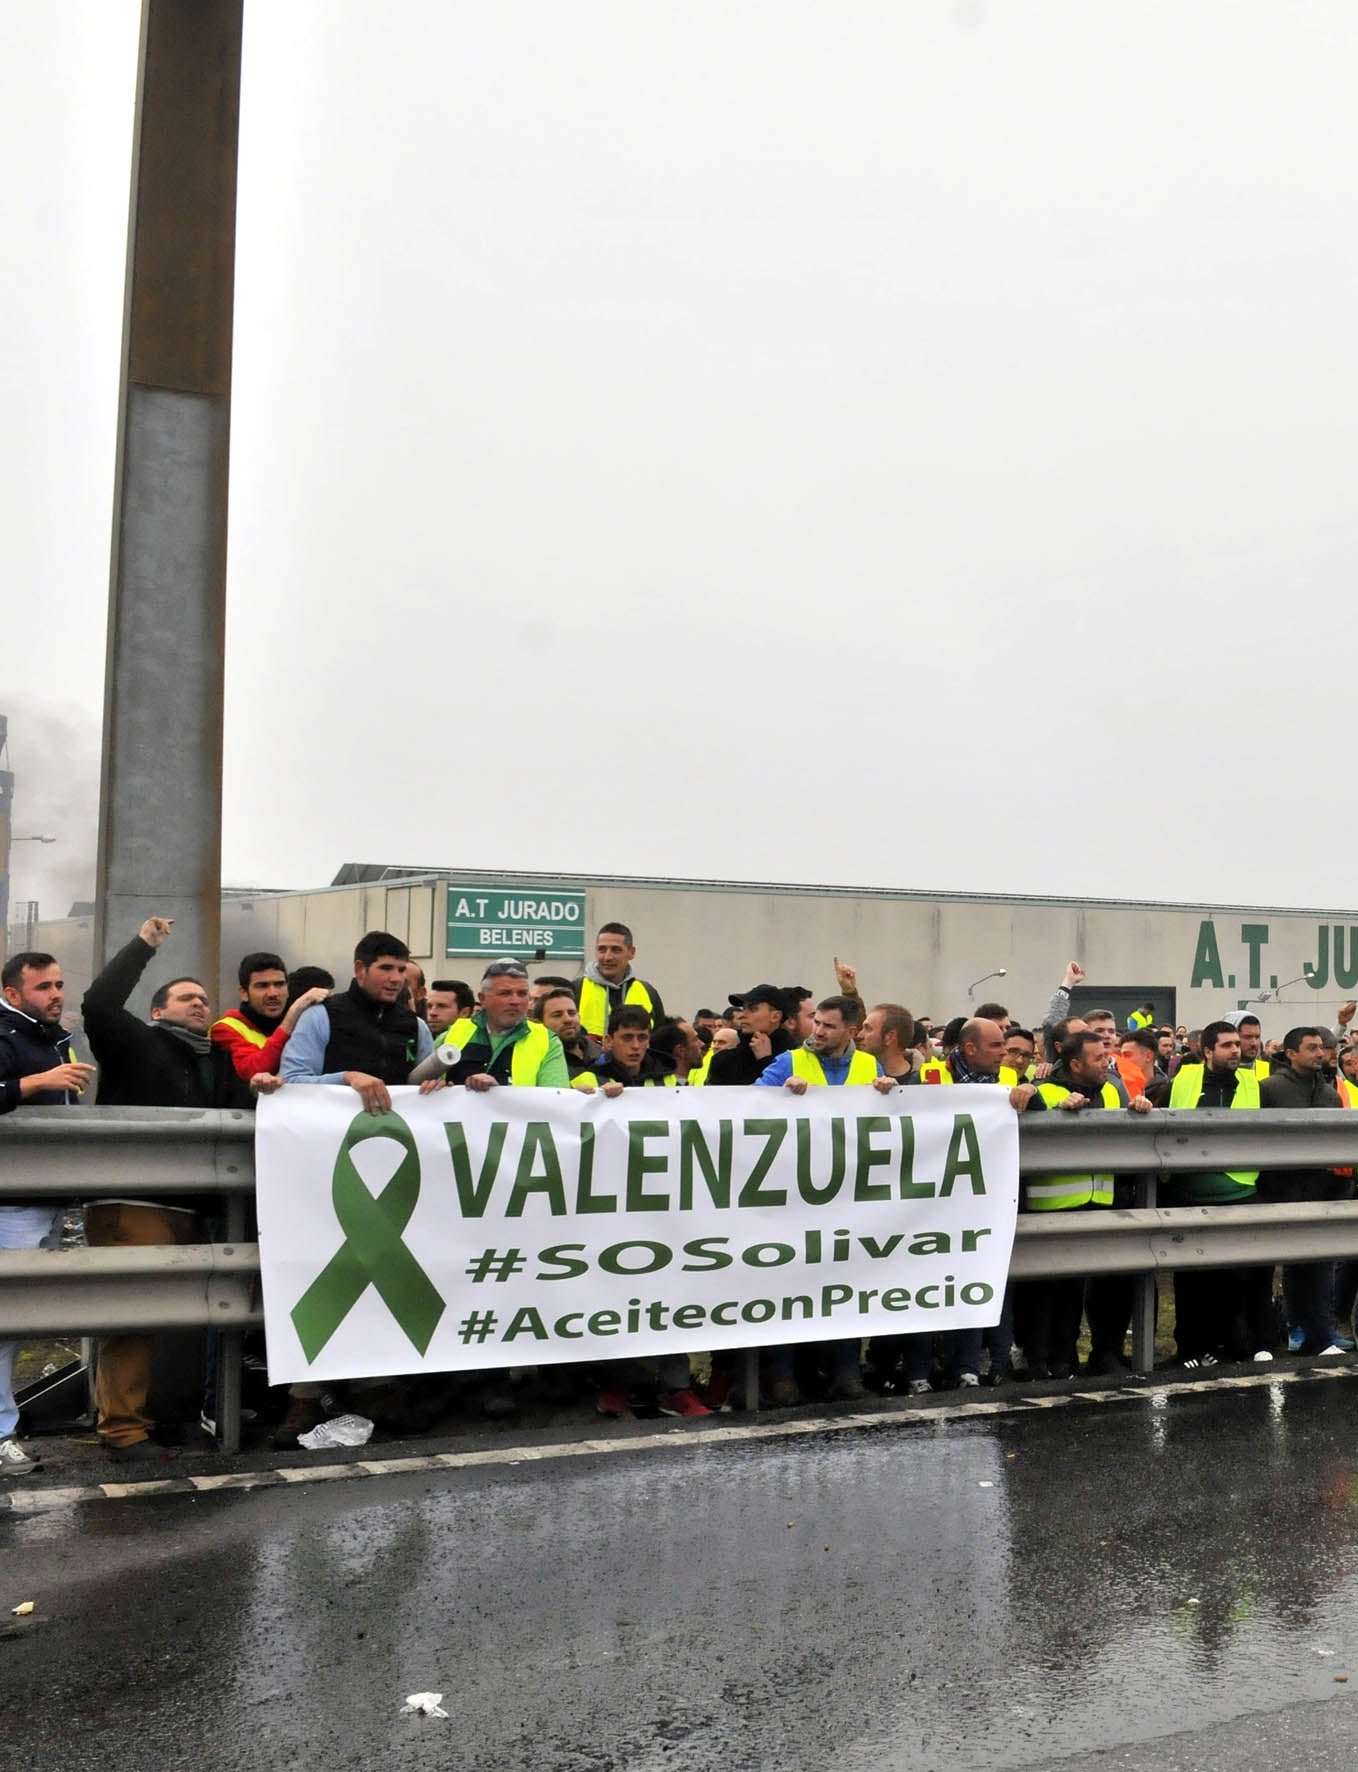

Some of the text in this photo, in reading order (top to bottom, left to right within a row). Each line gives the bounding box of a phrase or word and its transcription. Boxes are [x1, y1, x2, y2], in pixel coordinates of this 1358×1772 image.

[479, 928, 554, 946] BELENES
[497, 899, 580, 921] JURADO
[1190, 920, 1278, 989] A.T.
[443, 1113, 987, 1218] VALENZUELA
[465, 1228, 992, 1283] #SOSolivar
[457, 1275, 994, 1344] #AceiteconPrecio
